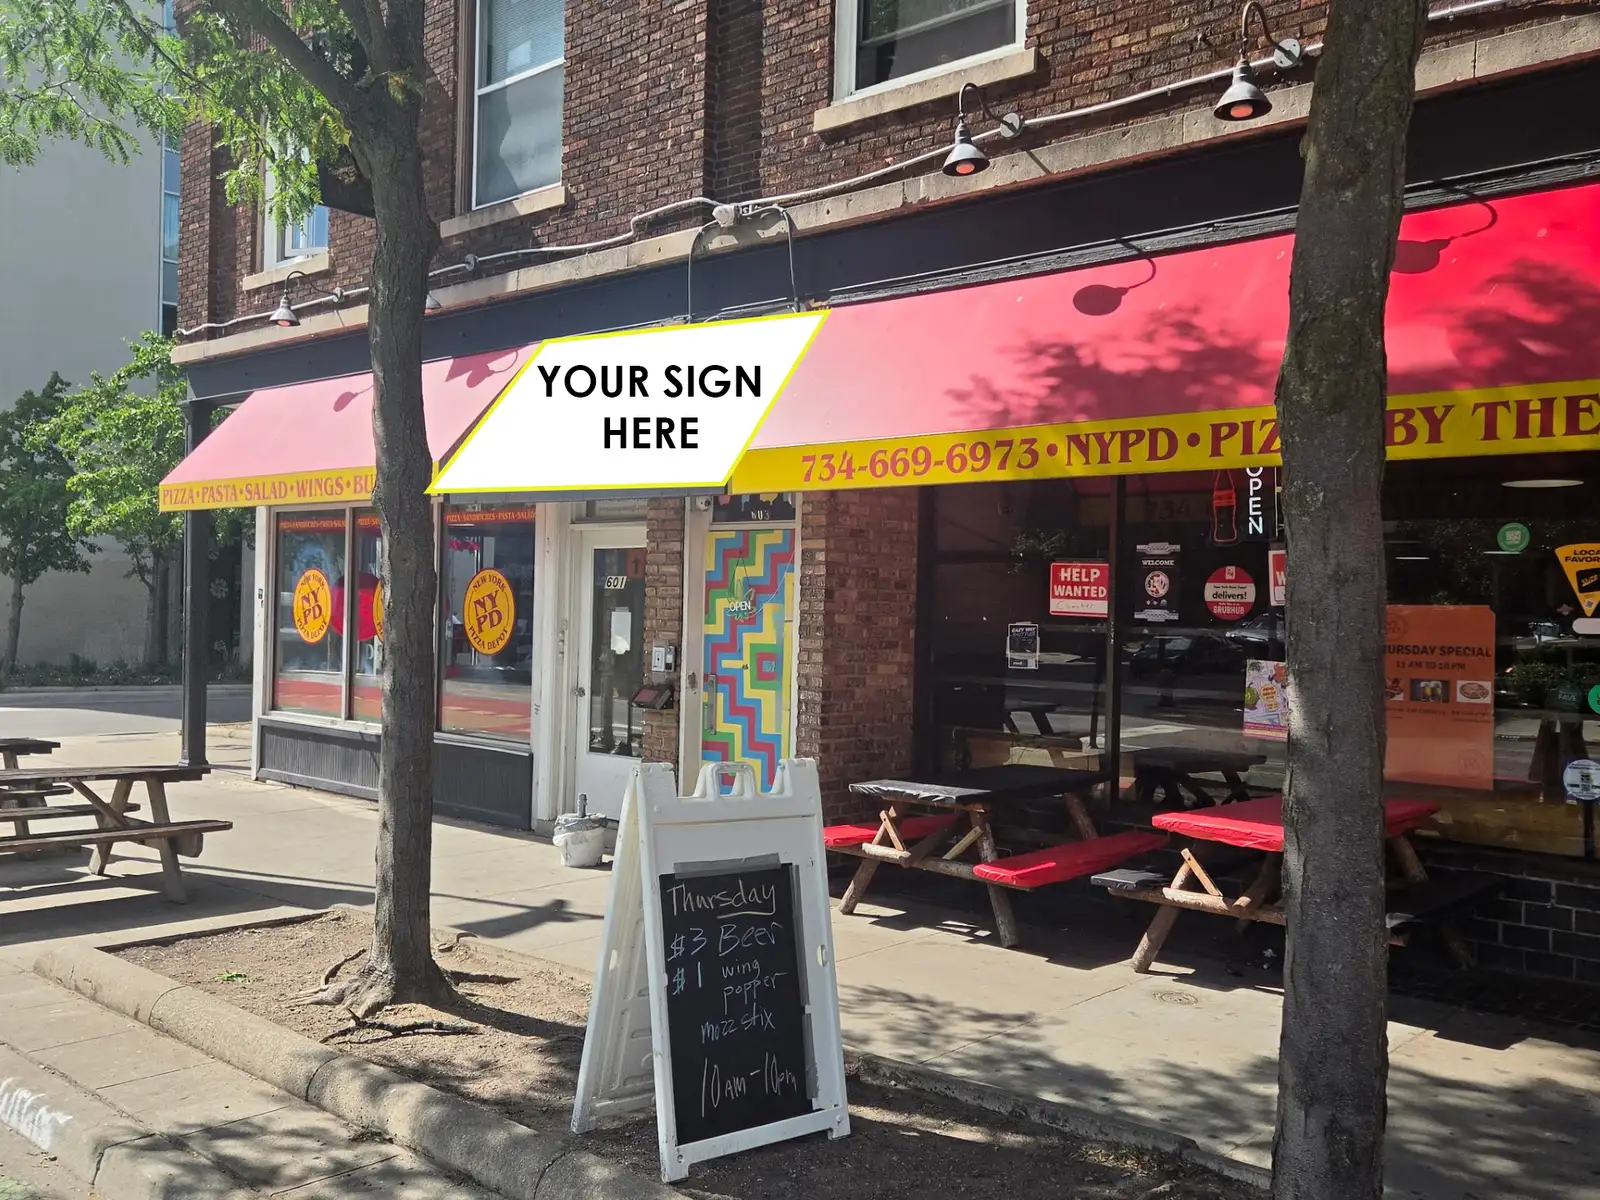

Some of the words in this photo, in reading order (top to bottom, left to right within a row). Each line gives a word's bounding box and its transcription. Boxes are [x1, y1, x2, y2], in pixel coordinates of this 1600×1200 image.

[801, 437, 1039, 483] 734-669-6973
[1065, 428, 1179, 466] NYPD
[1386, 403, 1455, 446] BY
[1471, 393, 1600, 441] THE
[163, 487, 194, 505] PIZZA
[201, 484, 238, 504] PASTA
[244, 480, 288, 500] SALAD
[296, 477, 344, 498] WINGS
[488, 574, 506, 592] YORK
[606, 576, 625, 588] 601
[1060, 567, 1101, 582] HELP
[1053, 584, 1107, 598] WANTED
[1212, 590, 1247, 600] delivers!
[473, 590, 500, 617] NY
[729, 600, 751, 611] OPEN
[1213, 605, 1245, 614] GRUBHUB
[476, 609, 503, 634] PD
[468, 625, 485, 649] PIZZA
[487, 626, 508, 650] DEPOT
[1439, 646, 1492, 658] SPECIAL
[666, 878, 776, 919] Thursday
[718, 921, 784, 957] Beer
[721, 958, 761, 981] wing
[723, 971, 788, 1015] popper
